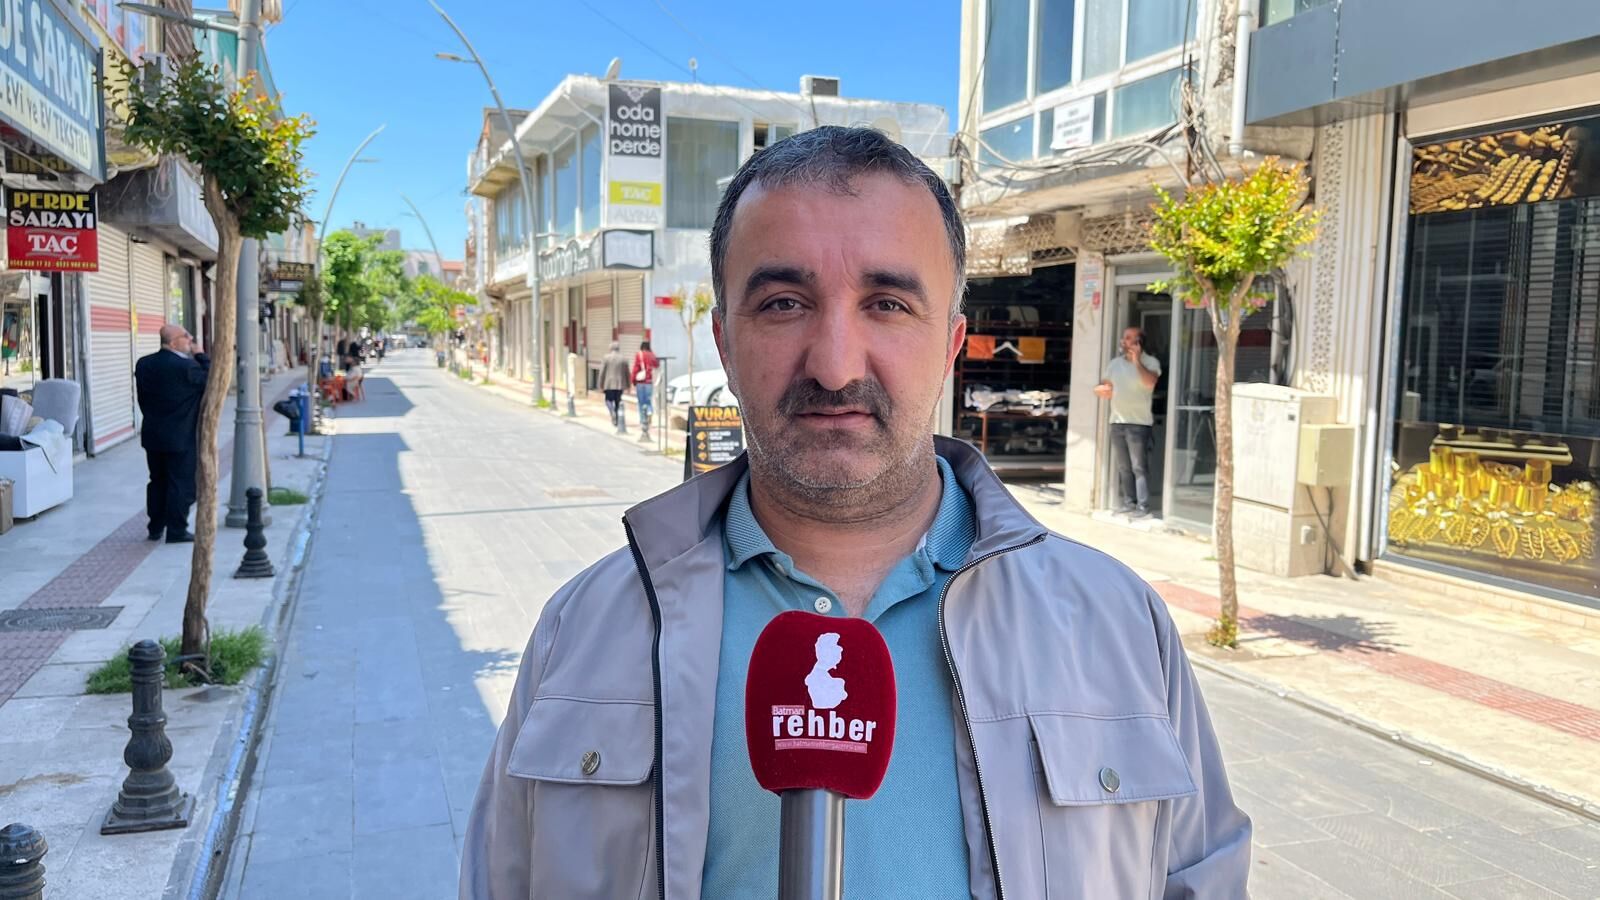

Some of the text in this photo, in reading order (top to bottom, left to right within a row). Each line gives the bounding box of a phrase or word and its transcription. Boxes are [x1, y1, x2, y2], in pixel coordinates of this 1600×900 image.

[30, 0, 100, 129] SARAYI
[617, 103, 654, 121] oda
[611, 120, 660, 138] home
[611, 138, 660, 155] perde
[14, 191, 90, 211] PERDE
[10, 210, 94, 229] SARAYI
[694, 408, 740, 420] VURAL
[772, 706, 804, 716] Batman
[772, 709, 877, 742] rehber
